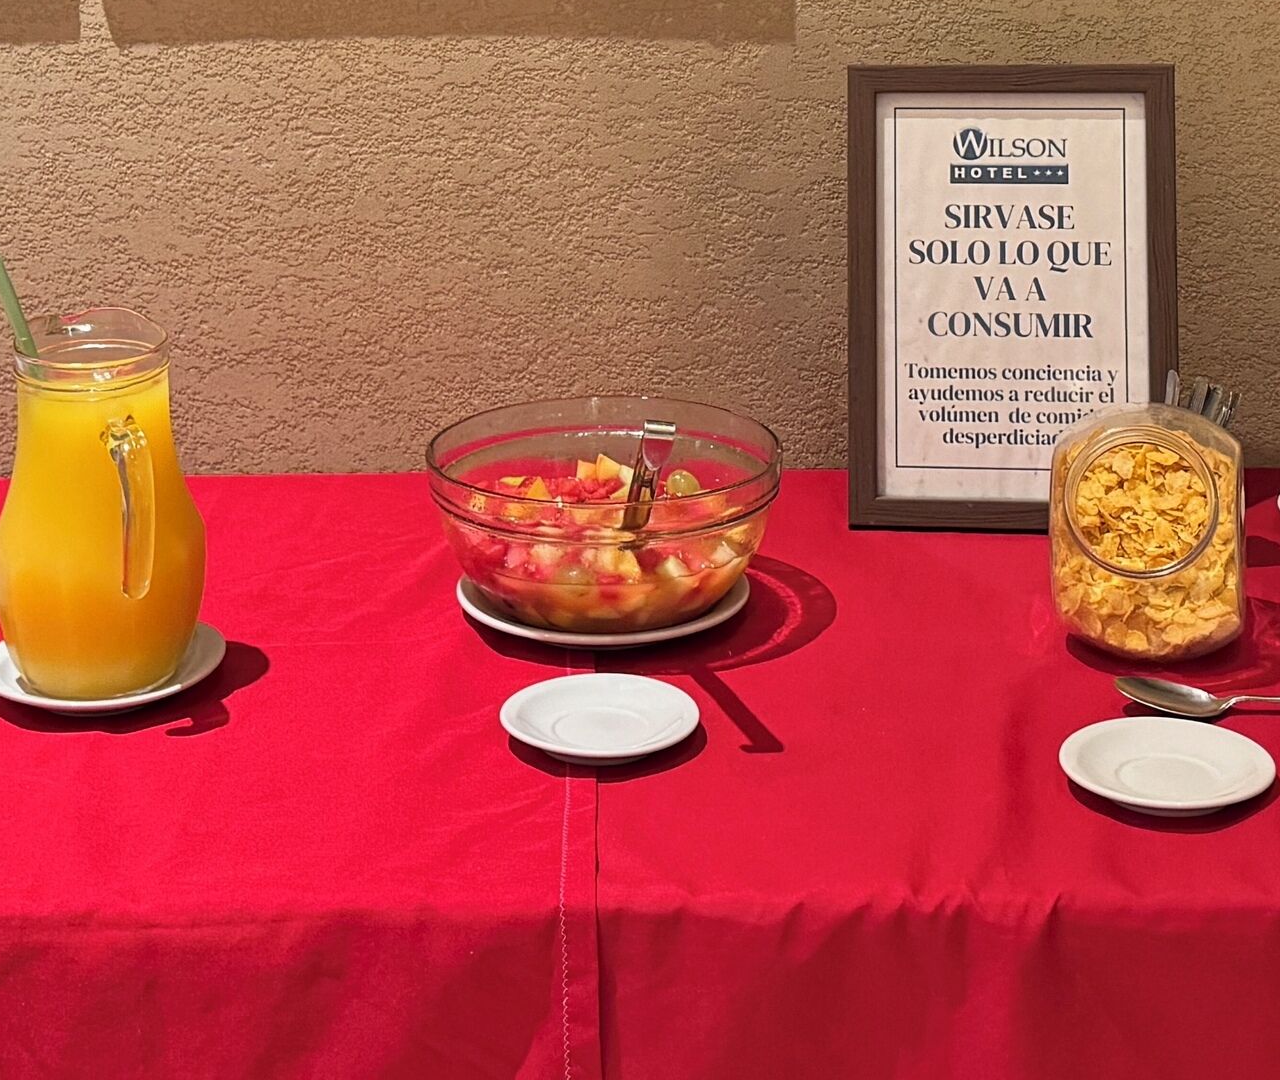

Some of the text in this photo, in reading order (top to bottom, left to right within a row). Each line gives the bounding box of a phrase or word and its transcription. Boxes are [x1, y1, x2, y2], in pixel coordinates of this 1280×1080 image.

[953, 128, 1068, 160] WILSON
[954, 167, 1027, 179] HOTEL
[944, 203, 1075, 230] SIRVASE
[908, 238, 1113, 273] SOLO LO QUE
[973, 276, 1047, 302] VA A
[927, 311, 1094, 338] CONSUMIR
[904, 362, 1118, 387] Tomemos conciencia y
[908, 384, 1115, 406] ayudemos a reducir el
[919, 404, 1093, 425] volúmen de comi
